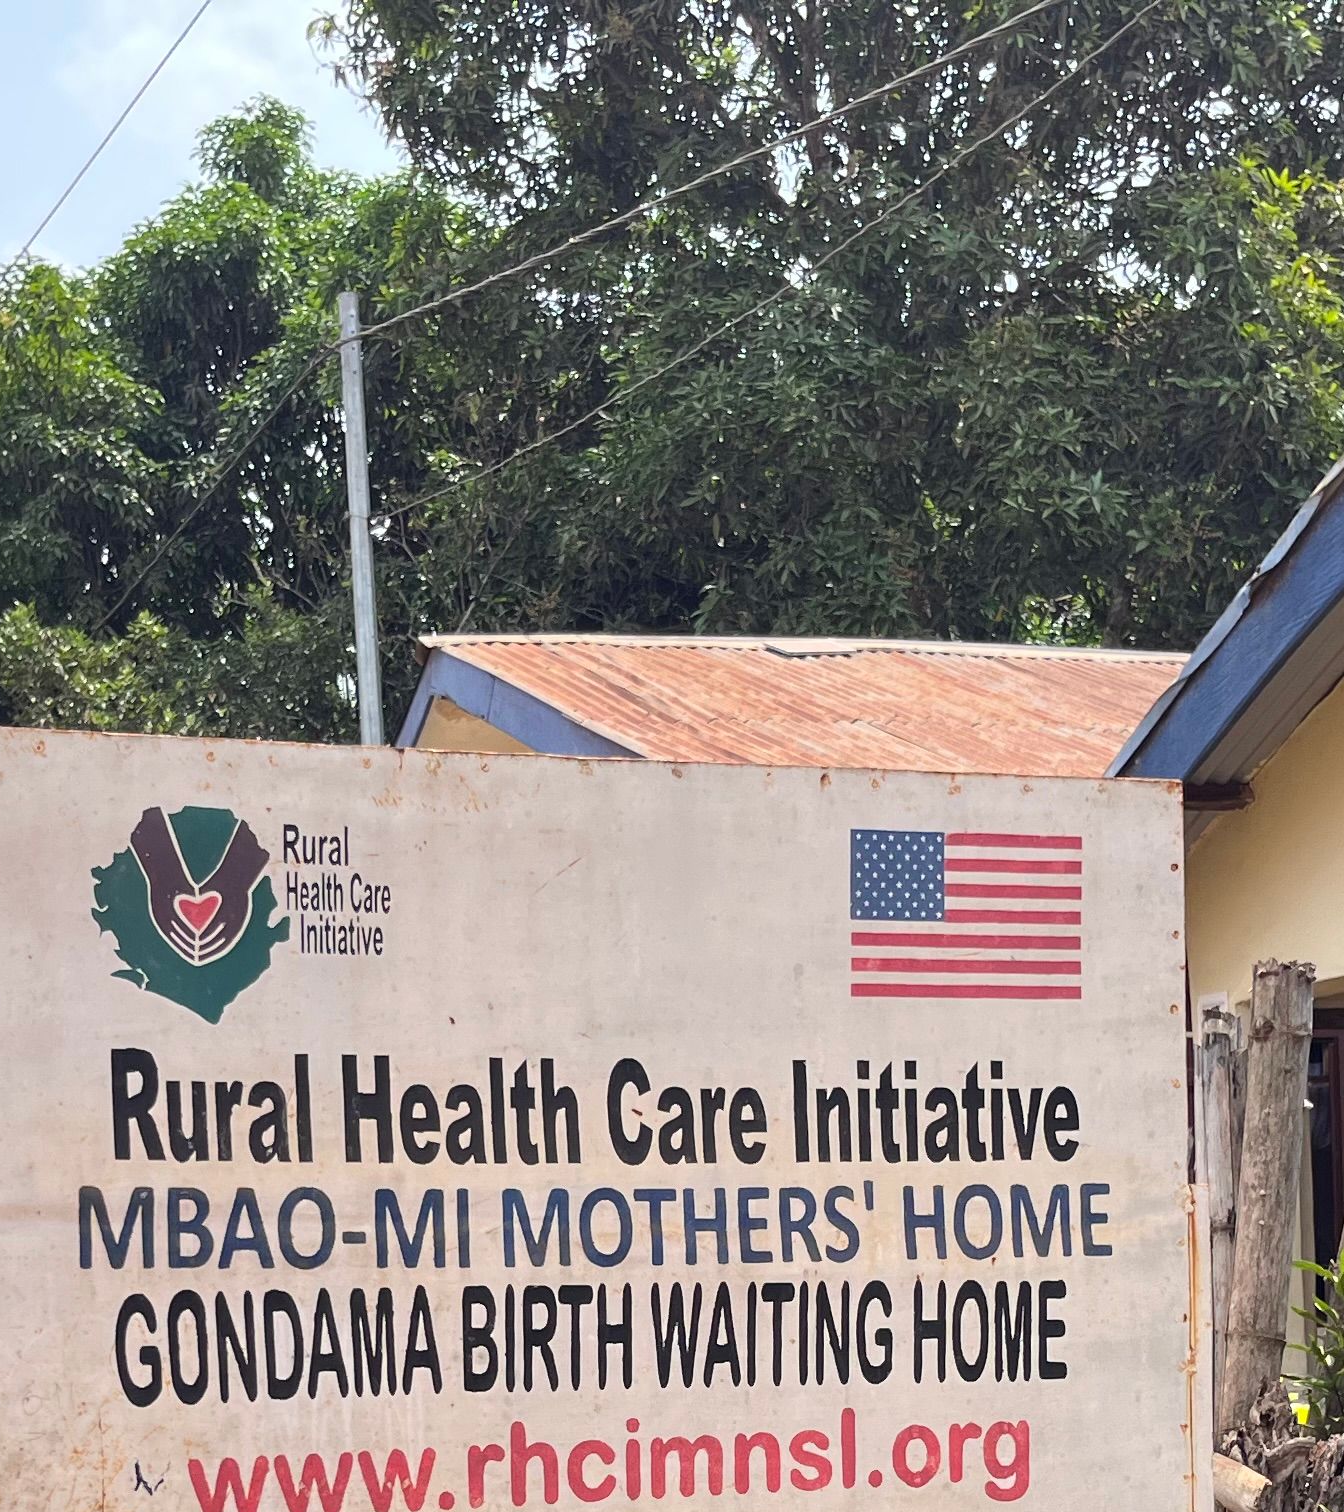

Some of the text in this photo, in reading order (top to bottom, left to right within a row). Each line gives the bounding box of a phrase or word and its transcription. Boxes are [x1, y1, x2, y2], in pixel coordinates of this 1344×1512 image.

[283, 823, 349, 866] Rural
[286, 871, 391, 914] Health Care
[300, 914, 383, 956] Initiative
[111, 1048, 1079, 1165] Rural Health Care Initiative
[79, 1181, 1112, 1269] MBAO-MI MOTHERS' HOME
[115, 1279, 1067, 1407] GONDAMA BIRTH WAITING HOME
